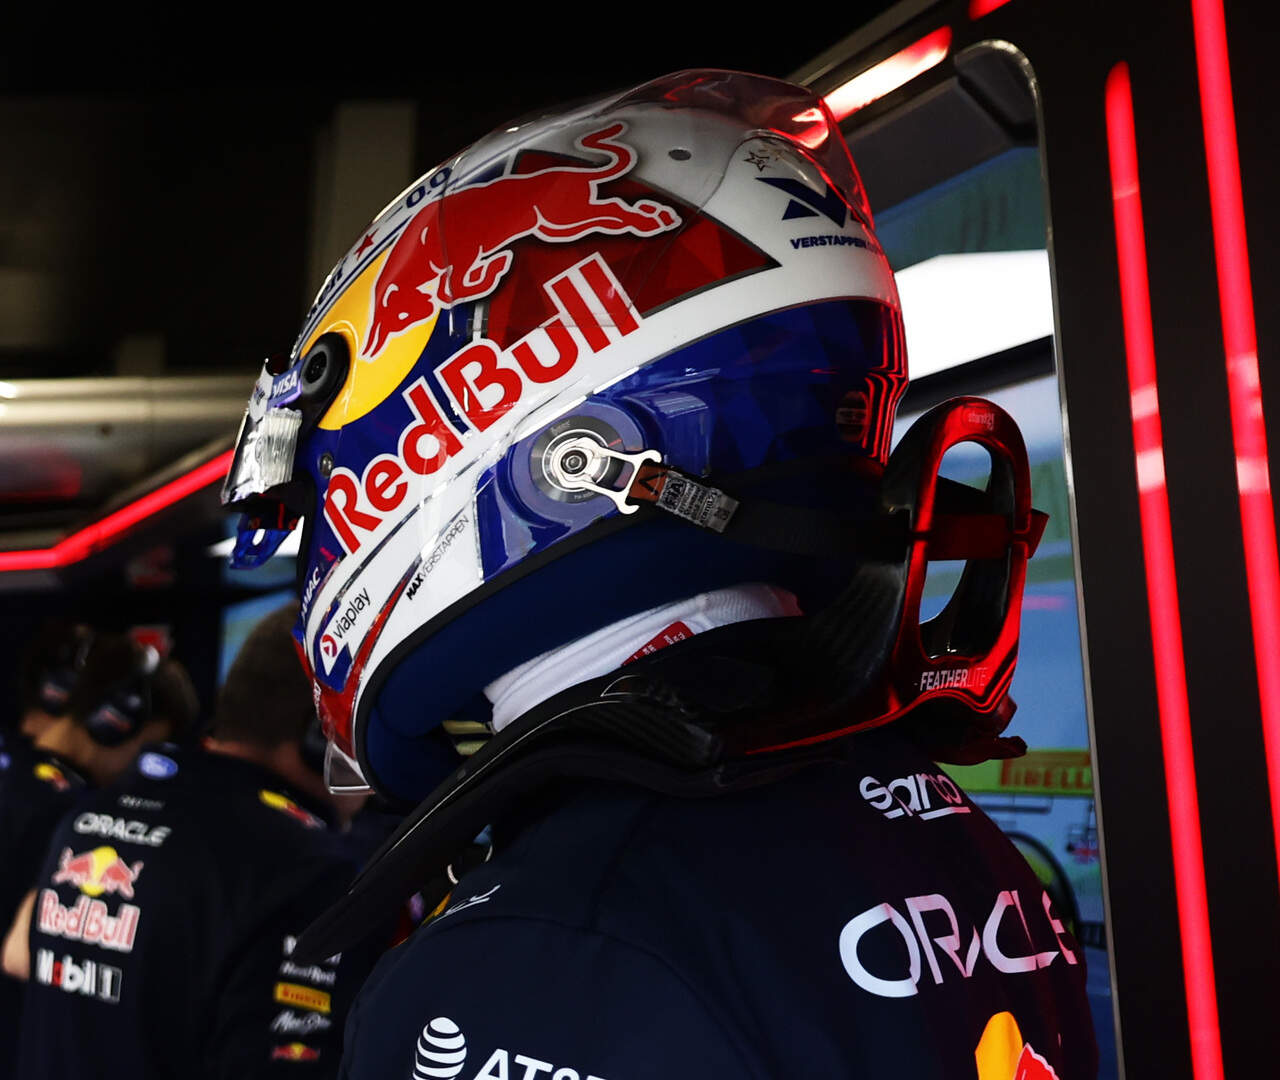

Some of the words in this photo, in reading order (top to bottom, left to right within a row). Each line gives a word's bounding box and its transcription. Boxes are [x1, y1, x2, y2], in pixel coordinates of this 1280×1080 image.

[324, 380, 463, 554] Red
[438, 256, 640, 431] Bull
[335, 587, 372, 639] viaplay
[920, 666, 988, 692] FEATHERLITE
[999, 752, 1094, 789] PIRELL
[74, 813, 172, 847] ORACLE
[37, 889, 85, 938] Red
[81, 895, 140, 952] Bull
[36, 949, 97, 997] Mobil
